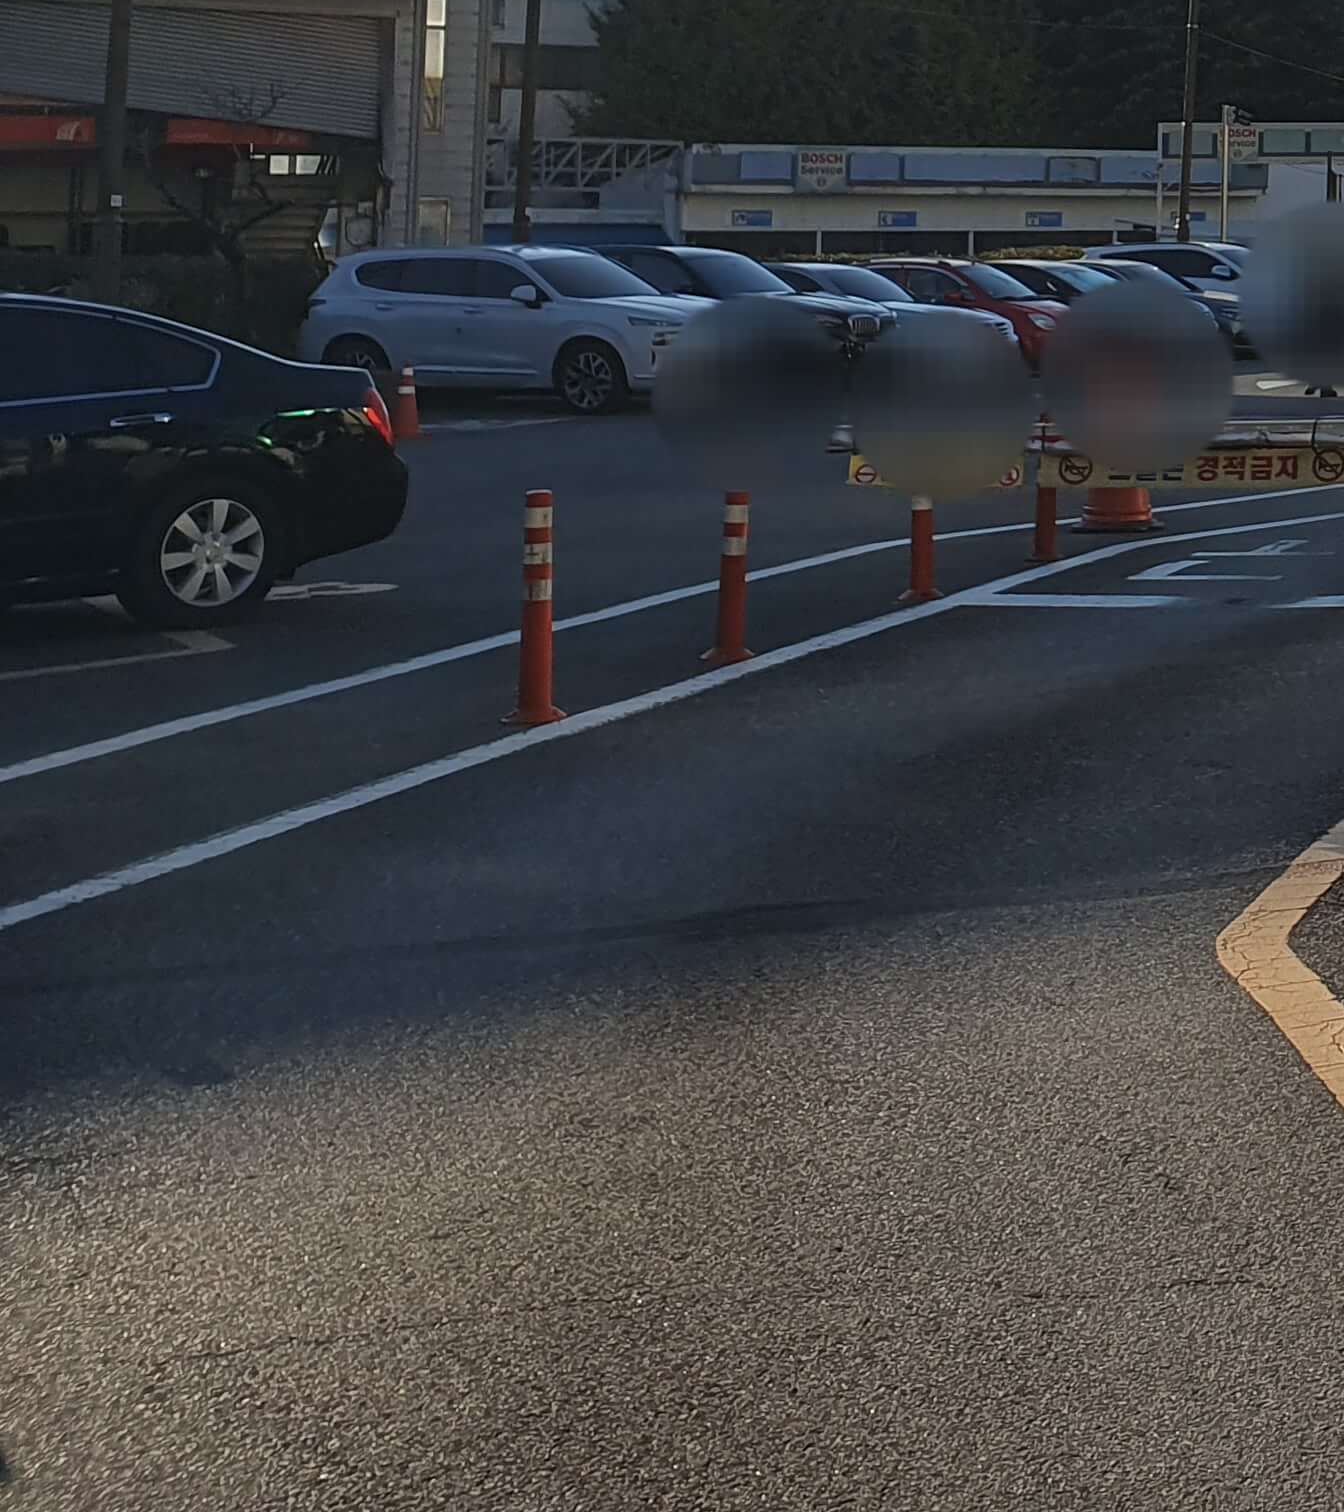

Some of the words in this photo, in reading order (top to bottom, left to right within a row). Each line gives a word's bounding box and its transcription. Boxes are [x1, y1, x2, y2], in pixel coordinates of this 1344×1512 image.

[800, 152, 843, 164] BOSCH
[800, 165, 843, 176] Service
[1195, 454, 1299, 481] 경적금지
